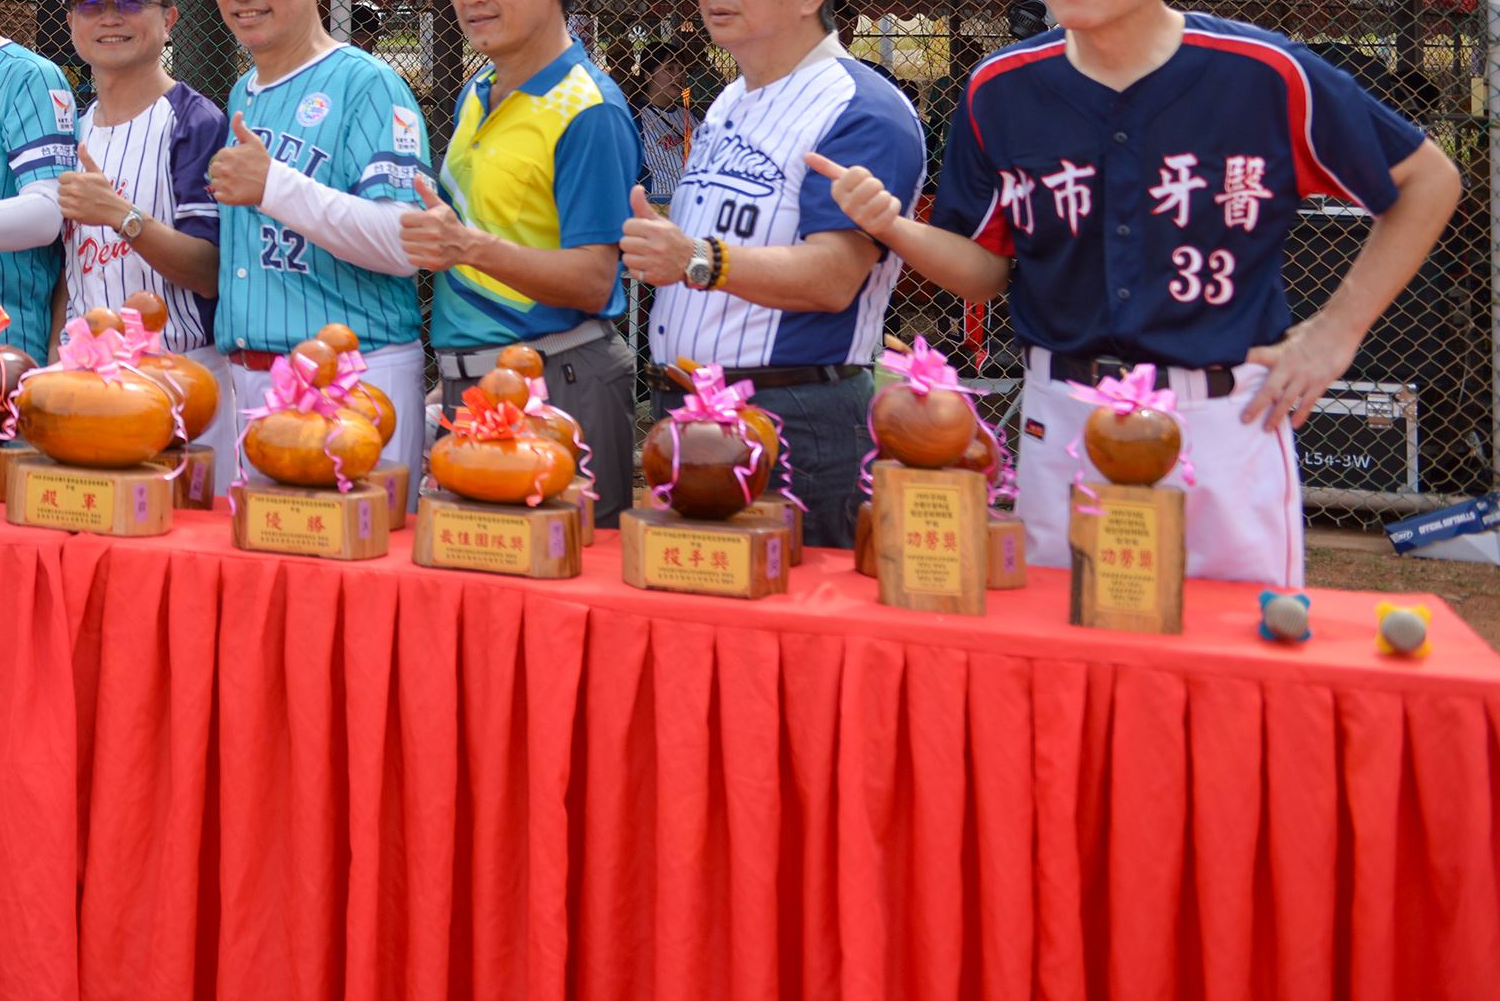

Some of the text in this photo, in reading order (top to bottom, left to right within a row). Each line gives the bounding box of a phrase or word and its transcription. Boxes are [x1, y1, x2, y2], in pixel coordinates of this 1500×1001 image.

[716, 199, 760, 239] 00
[261, 225, 309, 274] 22
[1169, 245, 1236, 305] 33
